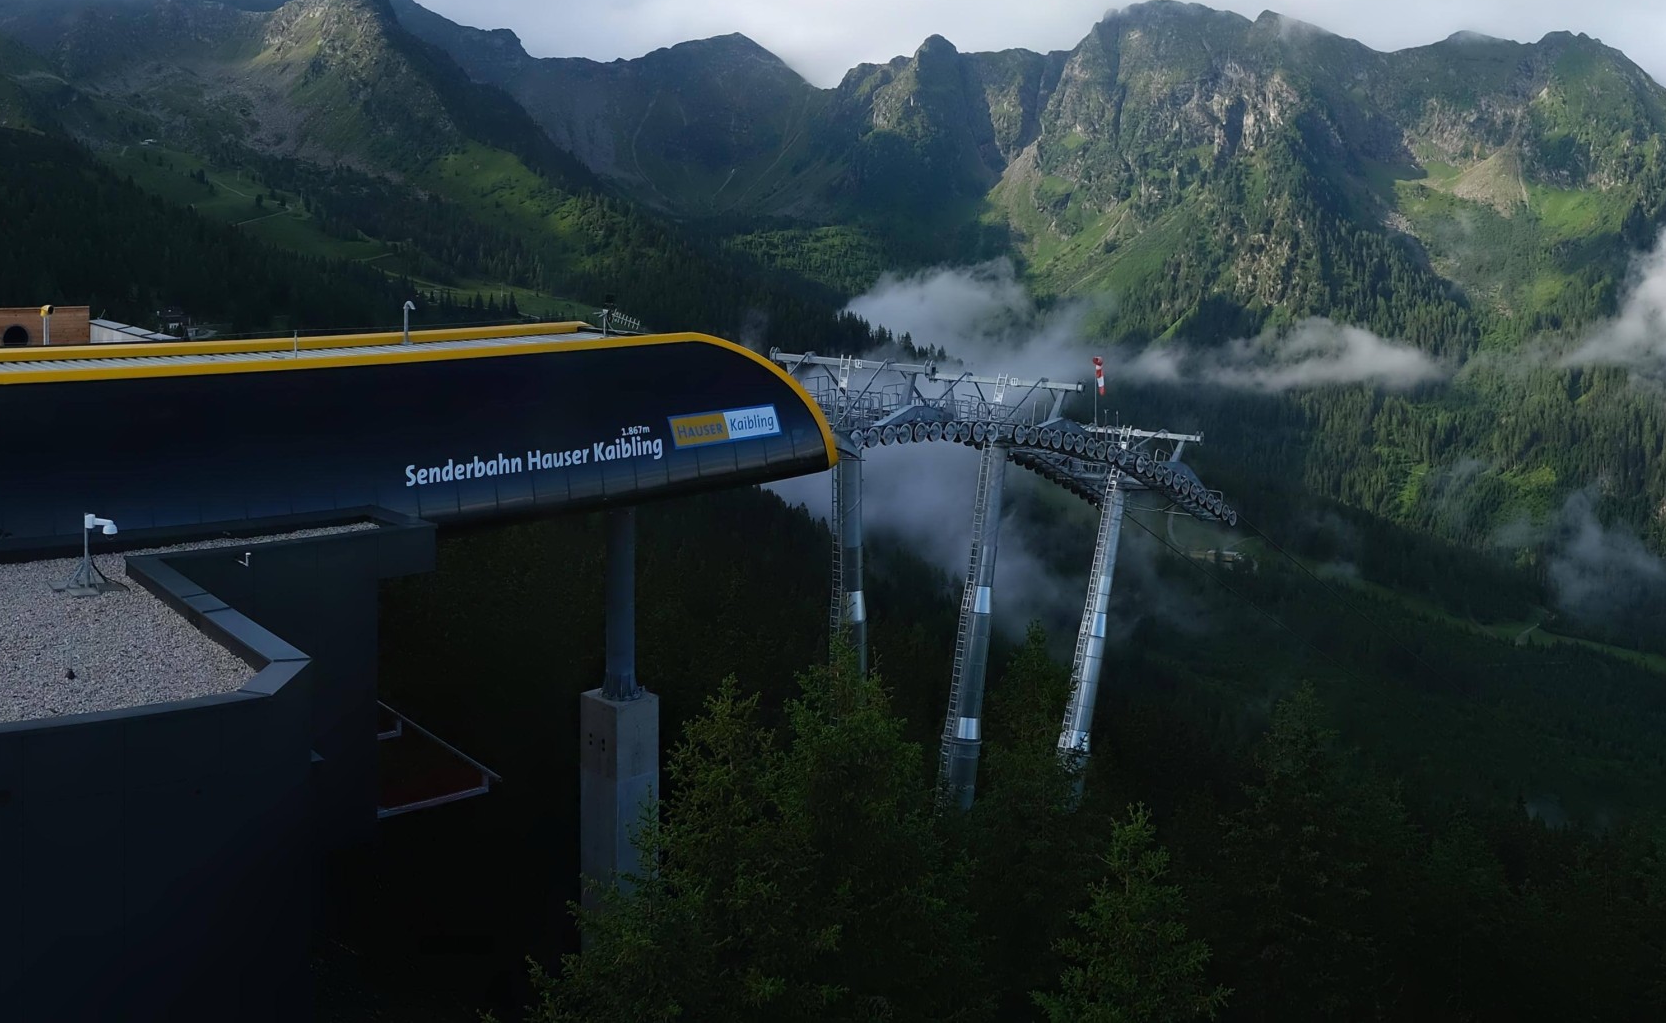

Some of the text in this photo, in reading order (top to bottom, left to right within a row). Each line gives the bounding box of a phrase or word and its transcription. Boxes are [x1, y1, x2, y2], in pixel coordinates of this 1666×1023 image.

[621, 425, 650, 436] 1.867m
[676, 413, 775, 440] HAUSER Kaibling
[405, 436, 663, 487] Senderbahn Hauser Kaibling
